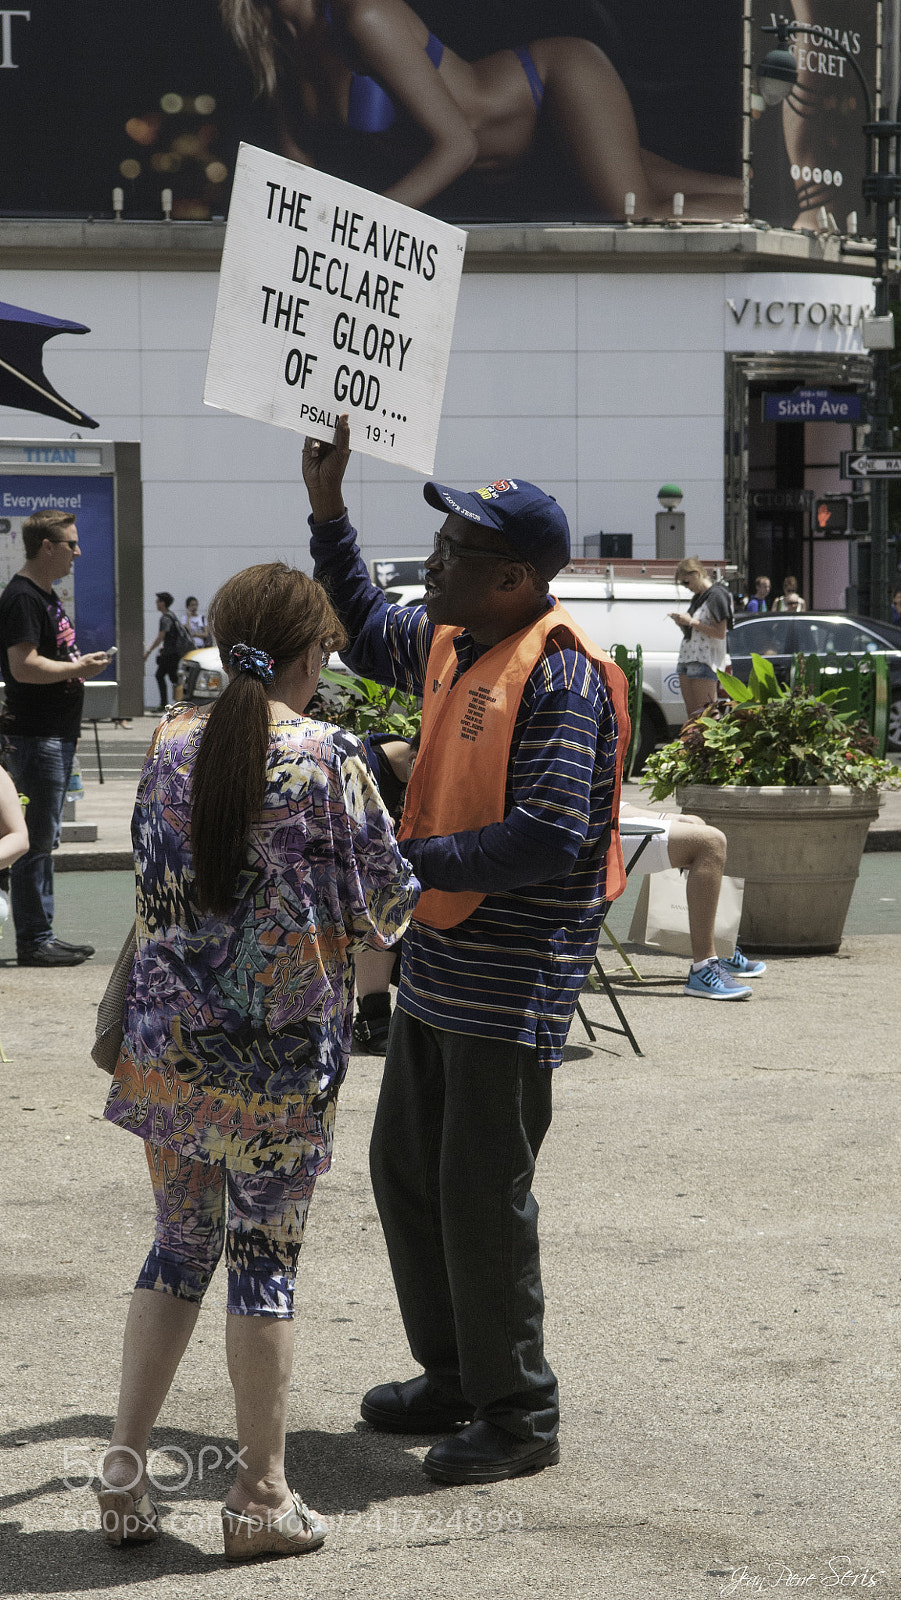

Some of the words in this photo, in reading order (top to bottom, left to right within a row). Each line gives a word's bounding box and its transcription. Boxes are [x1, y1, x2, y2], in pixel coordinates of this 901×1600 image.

[266, 181, 312, 231] THE
[330, 205, 438, 281] HEAVENS
[292, 244, 404, 319] DECLARE
[261, 285, 310, 337] THE
[332, 311, 413, 372] GLORY
[284, 348, 318, 390] OF
[777, 399, 816, 416] Sixth
[819, 400, 849, 416] Ave
[365, 424, 396, 448] 19:1
[23, 447, 76, 463] TITAN
[858, 460, 876, 471] ONE
[3, 492, 82, 511] Everywhere!
